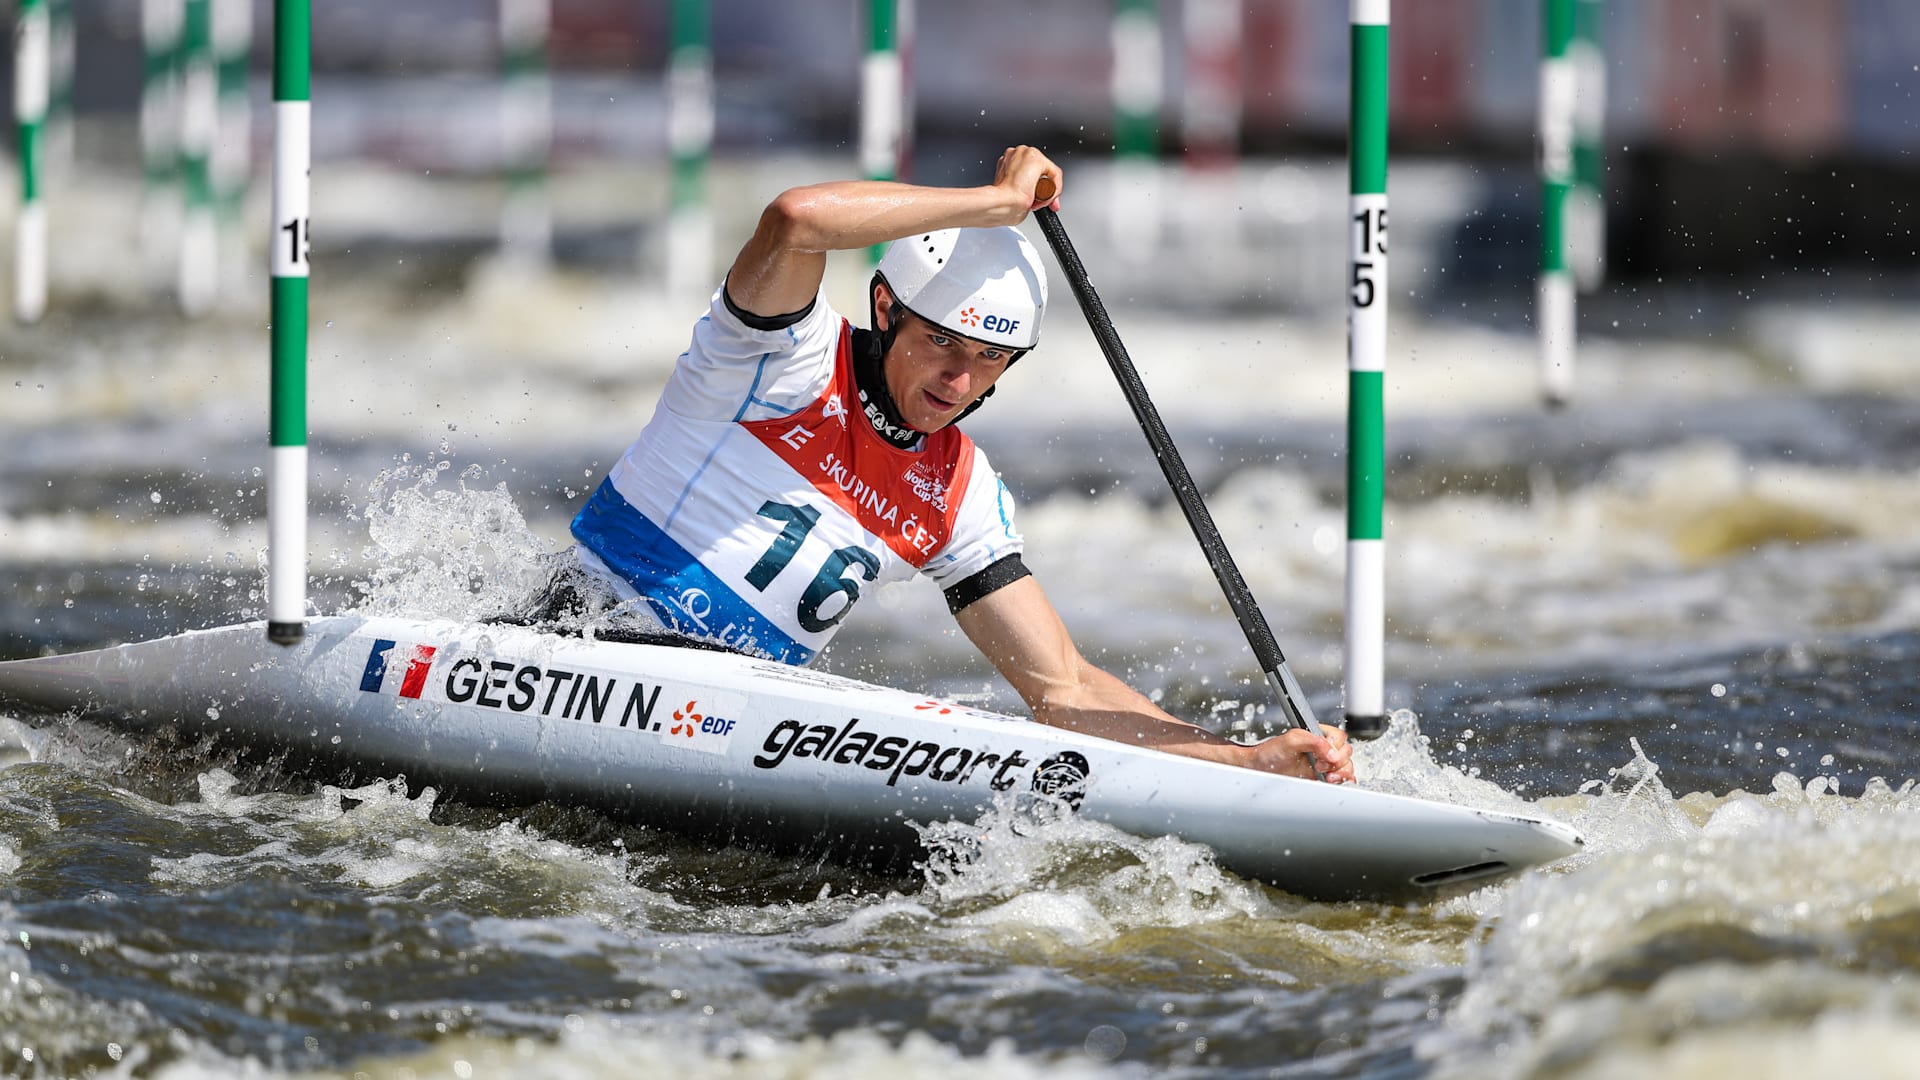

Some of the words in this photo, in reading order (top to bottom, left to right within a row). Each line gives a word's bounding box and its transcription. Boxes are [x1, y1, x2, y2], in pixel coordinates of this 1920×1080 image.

[818, 453, 898, 528] SKUPINA
[901, 512, 938, 556] ČEZ
[912, 485, 932, 502] Cup
[744, 500, 880, 633] 16
[445, 657, 616, 723] GESTIN
[619, 683, 662, 732] N.
[753, 718, 1030, 791] galasport
